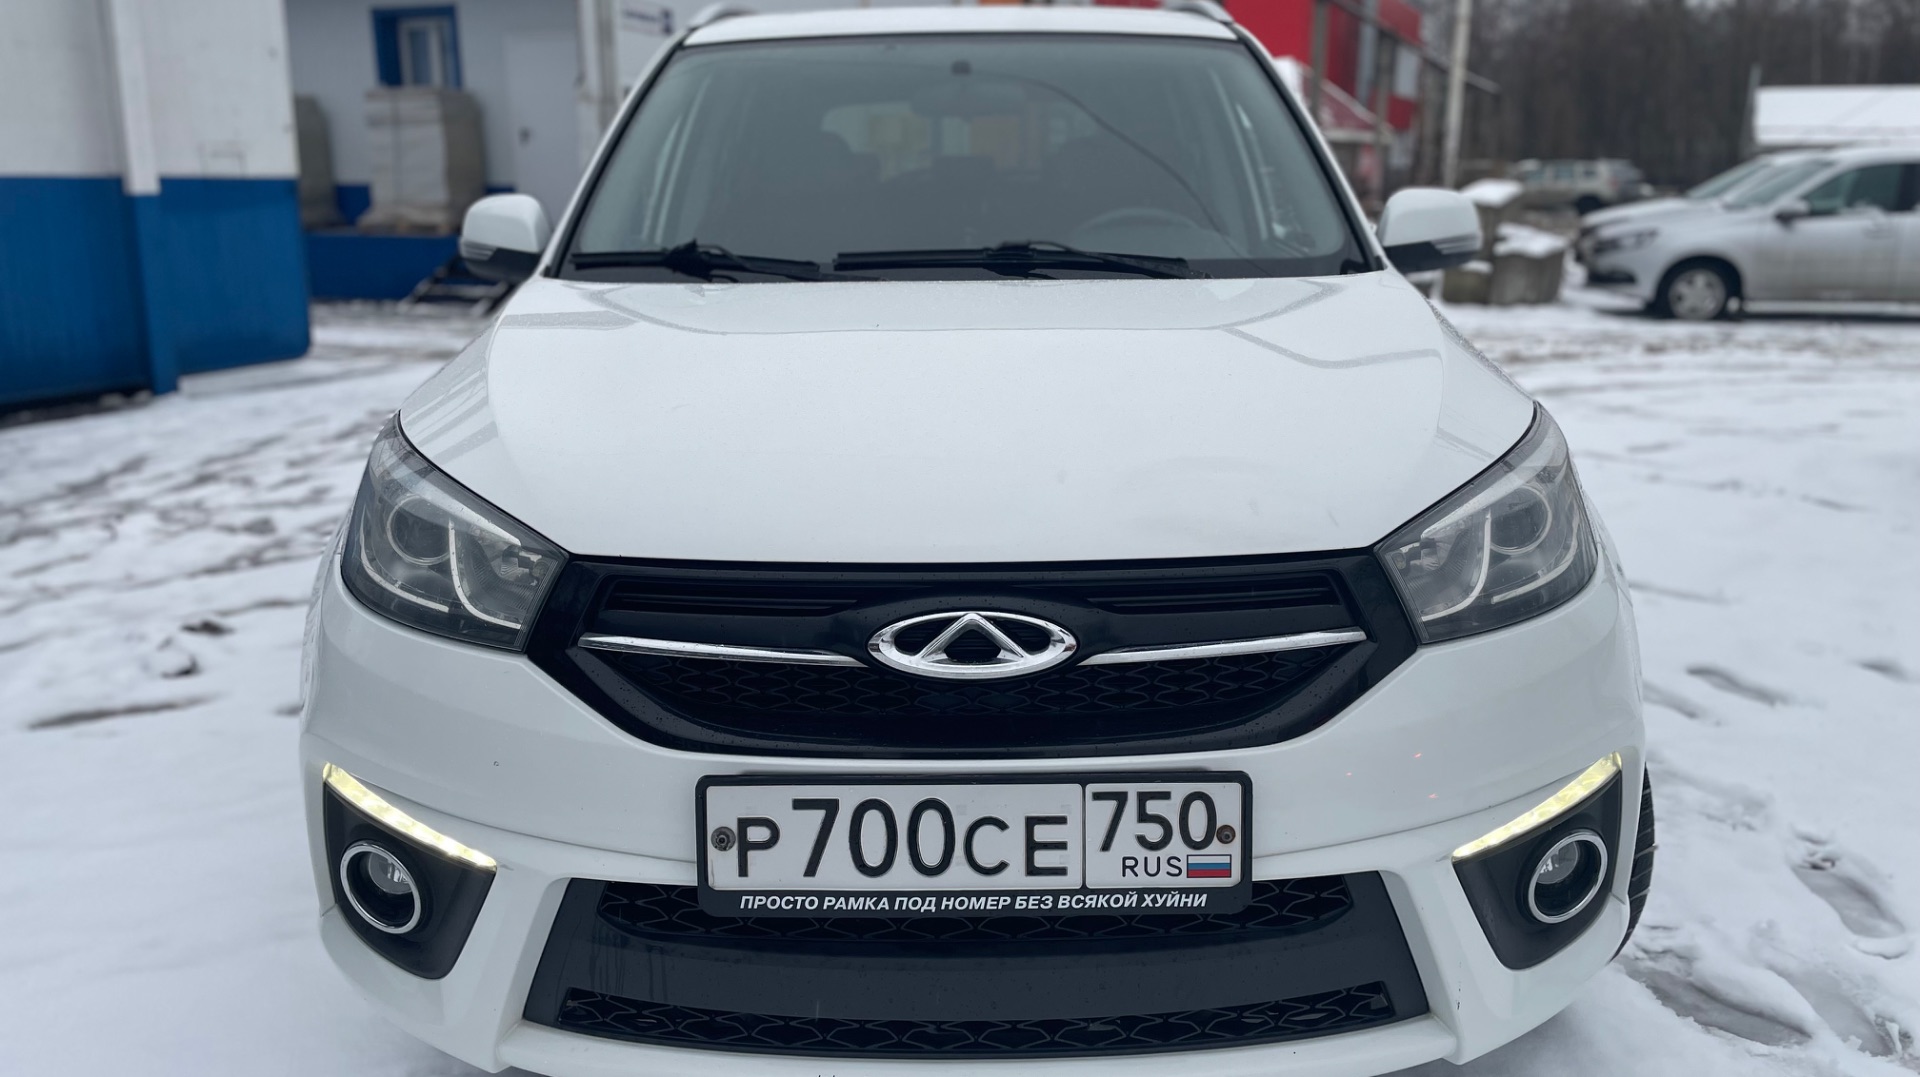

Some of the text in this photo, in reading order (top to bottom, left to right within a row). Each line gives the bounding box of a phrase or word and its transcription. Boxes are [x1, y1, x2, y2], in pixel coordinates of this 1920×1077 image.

[1092, 791, 1217, 852] 750
[1122, 856, 1183, 878] RUS
[740, 891, 1208, 912] ПРОСТО РАМКА ПОД НОМЕР БЕЗ ВСЯКОЙ ХУЙНИ
